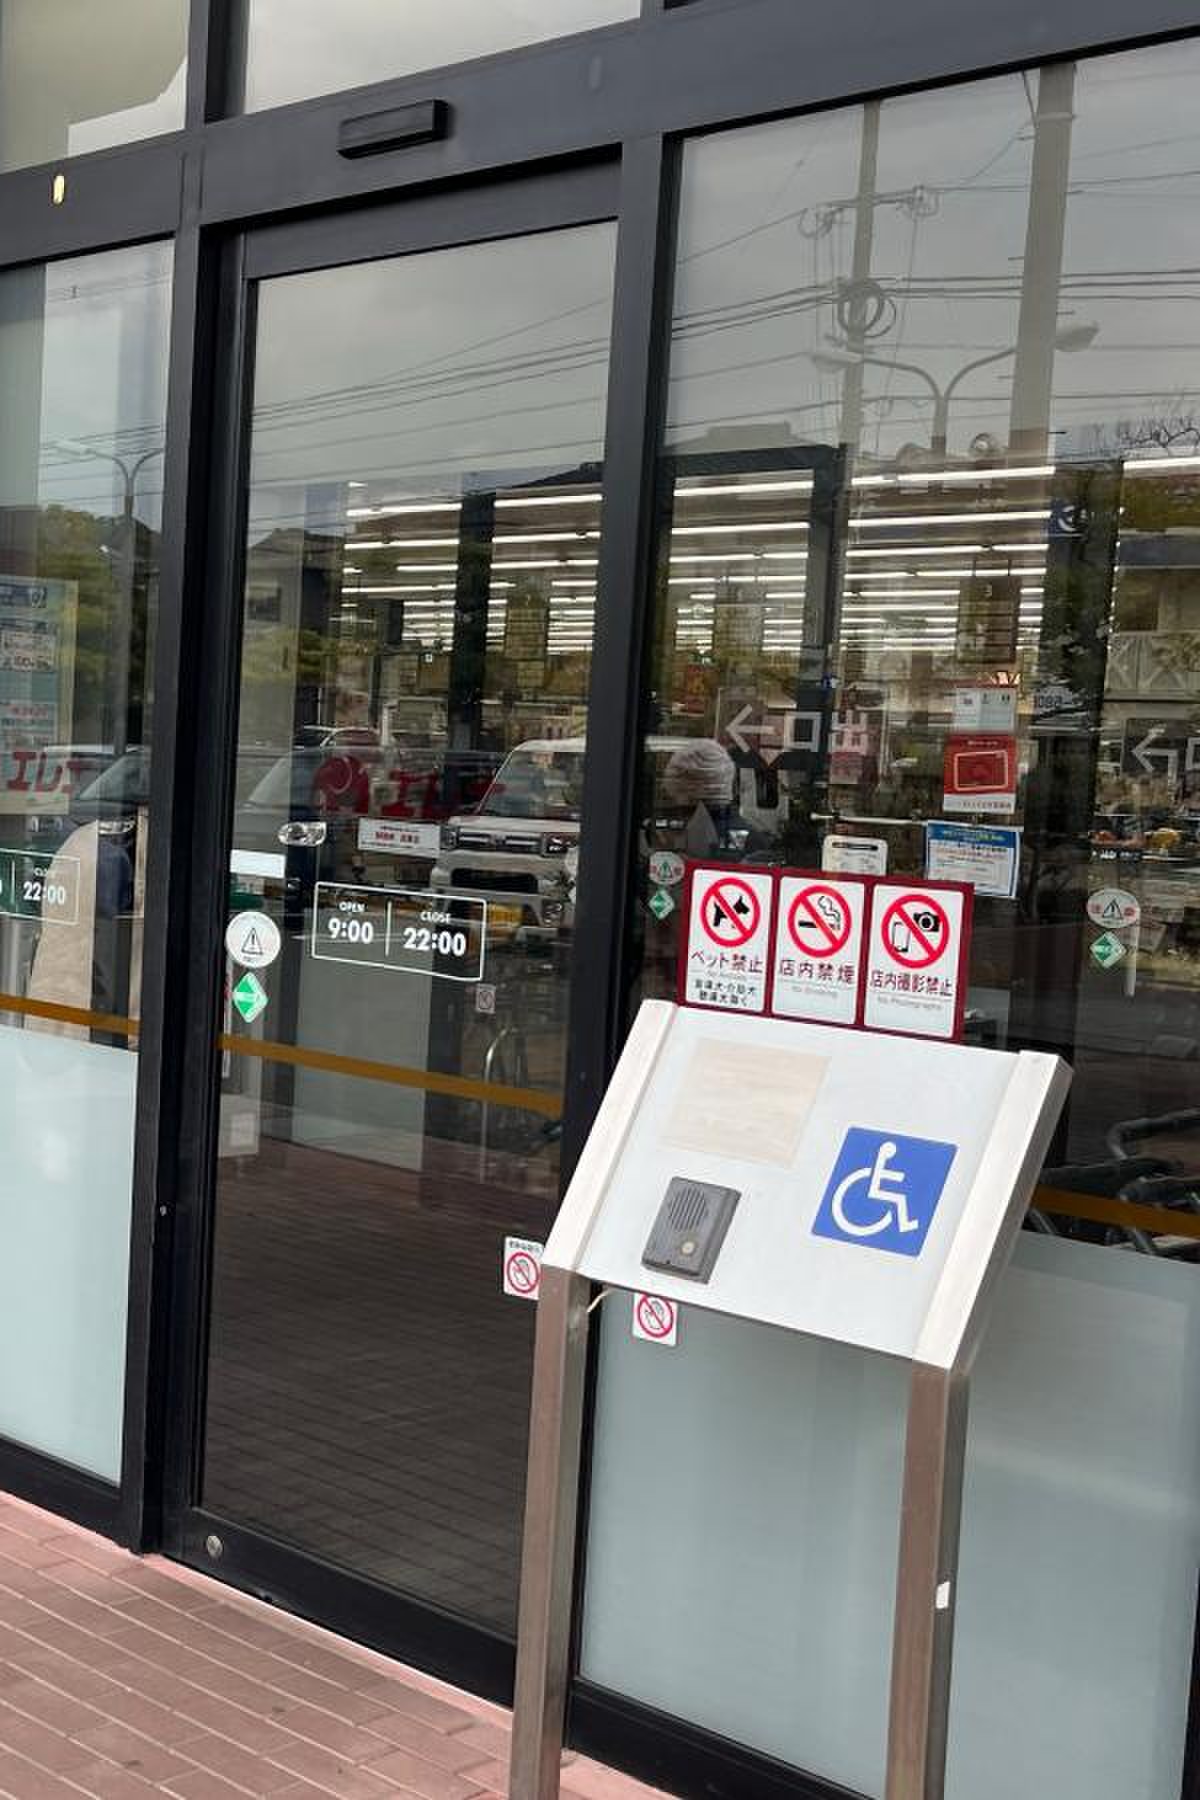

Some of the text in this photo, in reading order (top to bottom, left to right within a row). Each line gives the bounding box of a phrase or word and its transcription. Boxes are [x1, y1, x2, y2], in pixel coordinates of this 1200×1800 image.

[23, 881, 66, 906] 22:00
[338, 901, 366, 913] OPEN
[420, 911, 451, 924] CLOSE
[328, 917, 374, 944] 9:00
[403, 927, 466, 957] 22:00
[691, 951, 763, 974] ペット禁止
[778, 959, 855, 985] 店内禁煙
[869, 969, 954, 998] 店内撮影禁止
